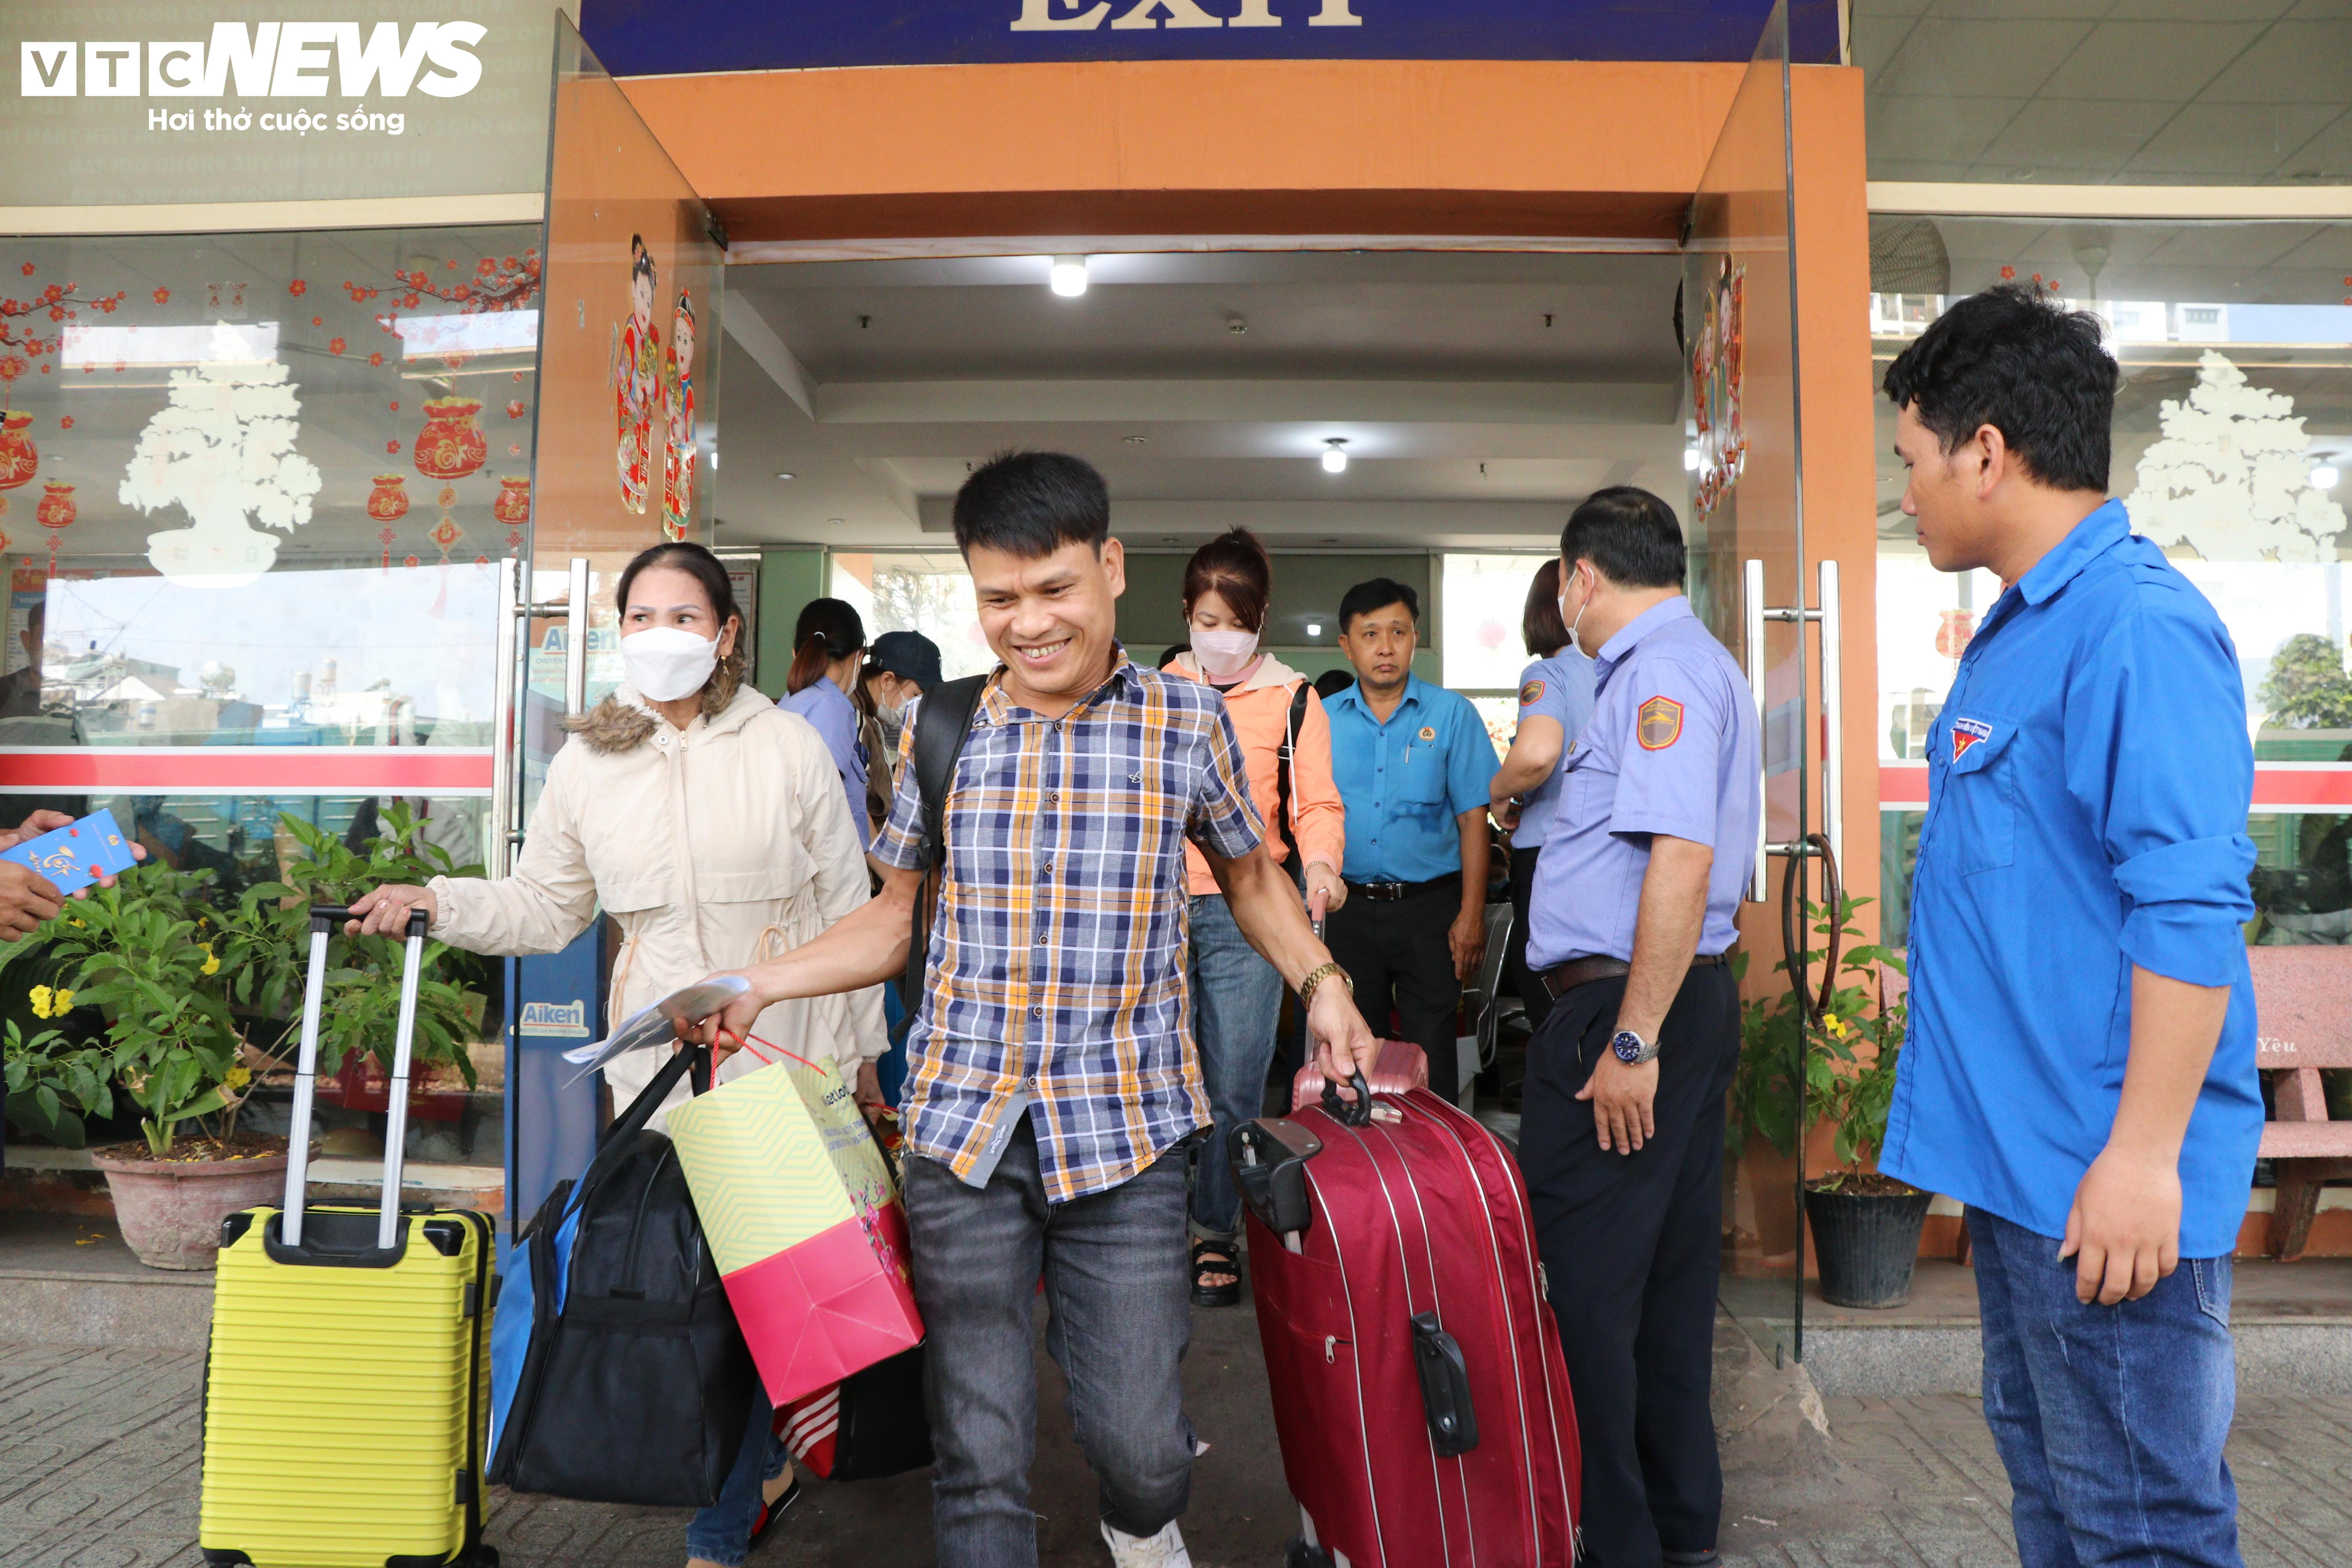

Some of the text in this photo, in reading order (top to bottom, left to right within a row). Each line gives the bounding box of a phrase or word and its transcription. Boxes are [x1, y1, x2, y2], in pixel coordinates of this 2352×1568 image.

[545, 629, 616, 650] Aien
[524, 1005, 580, 1024] Aiken
[2257, 1037, 2297, 1052] Yêu
